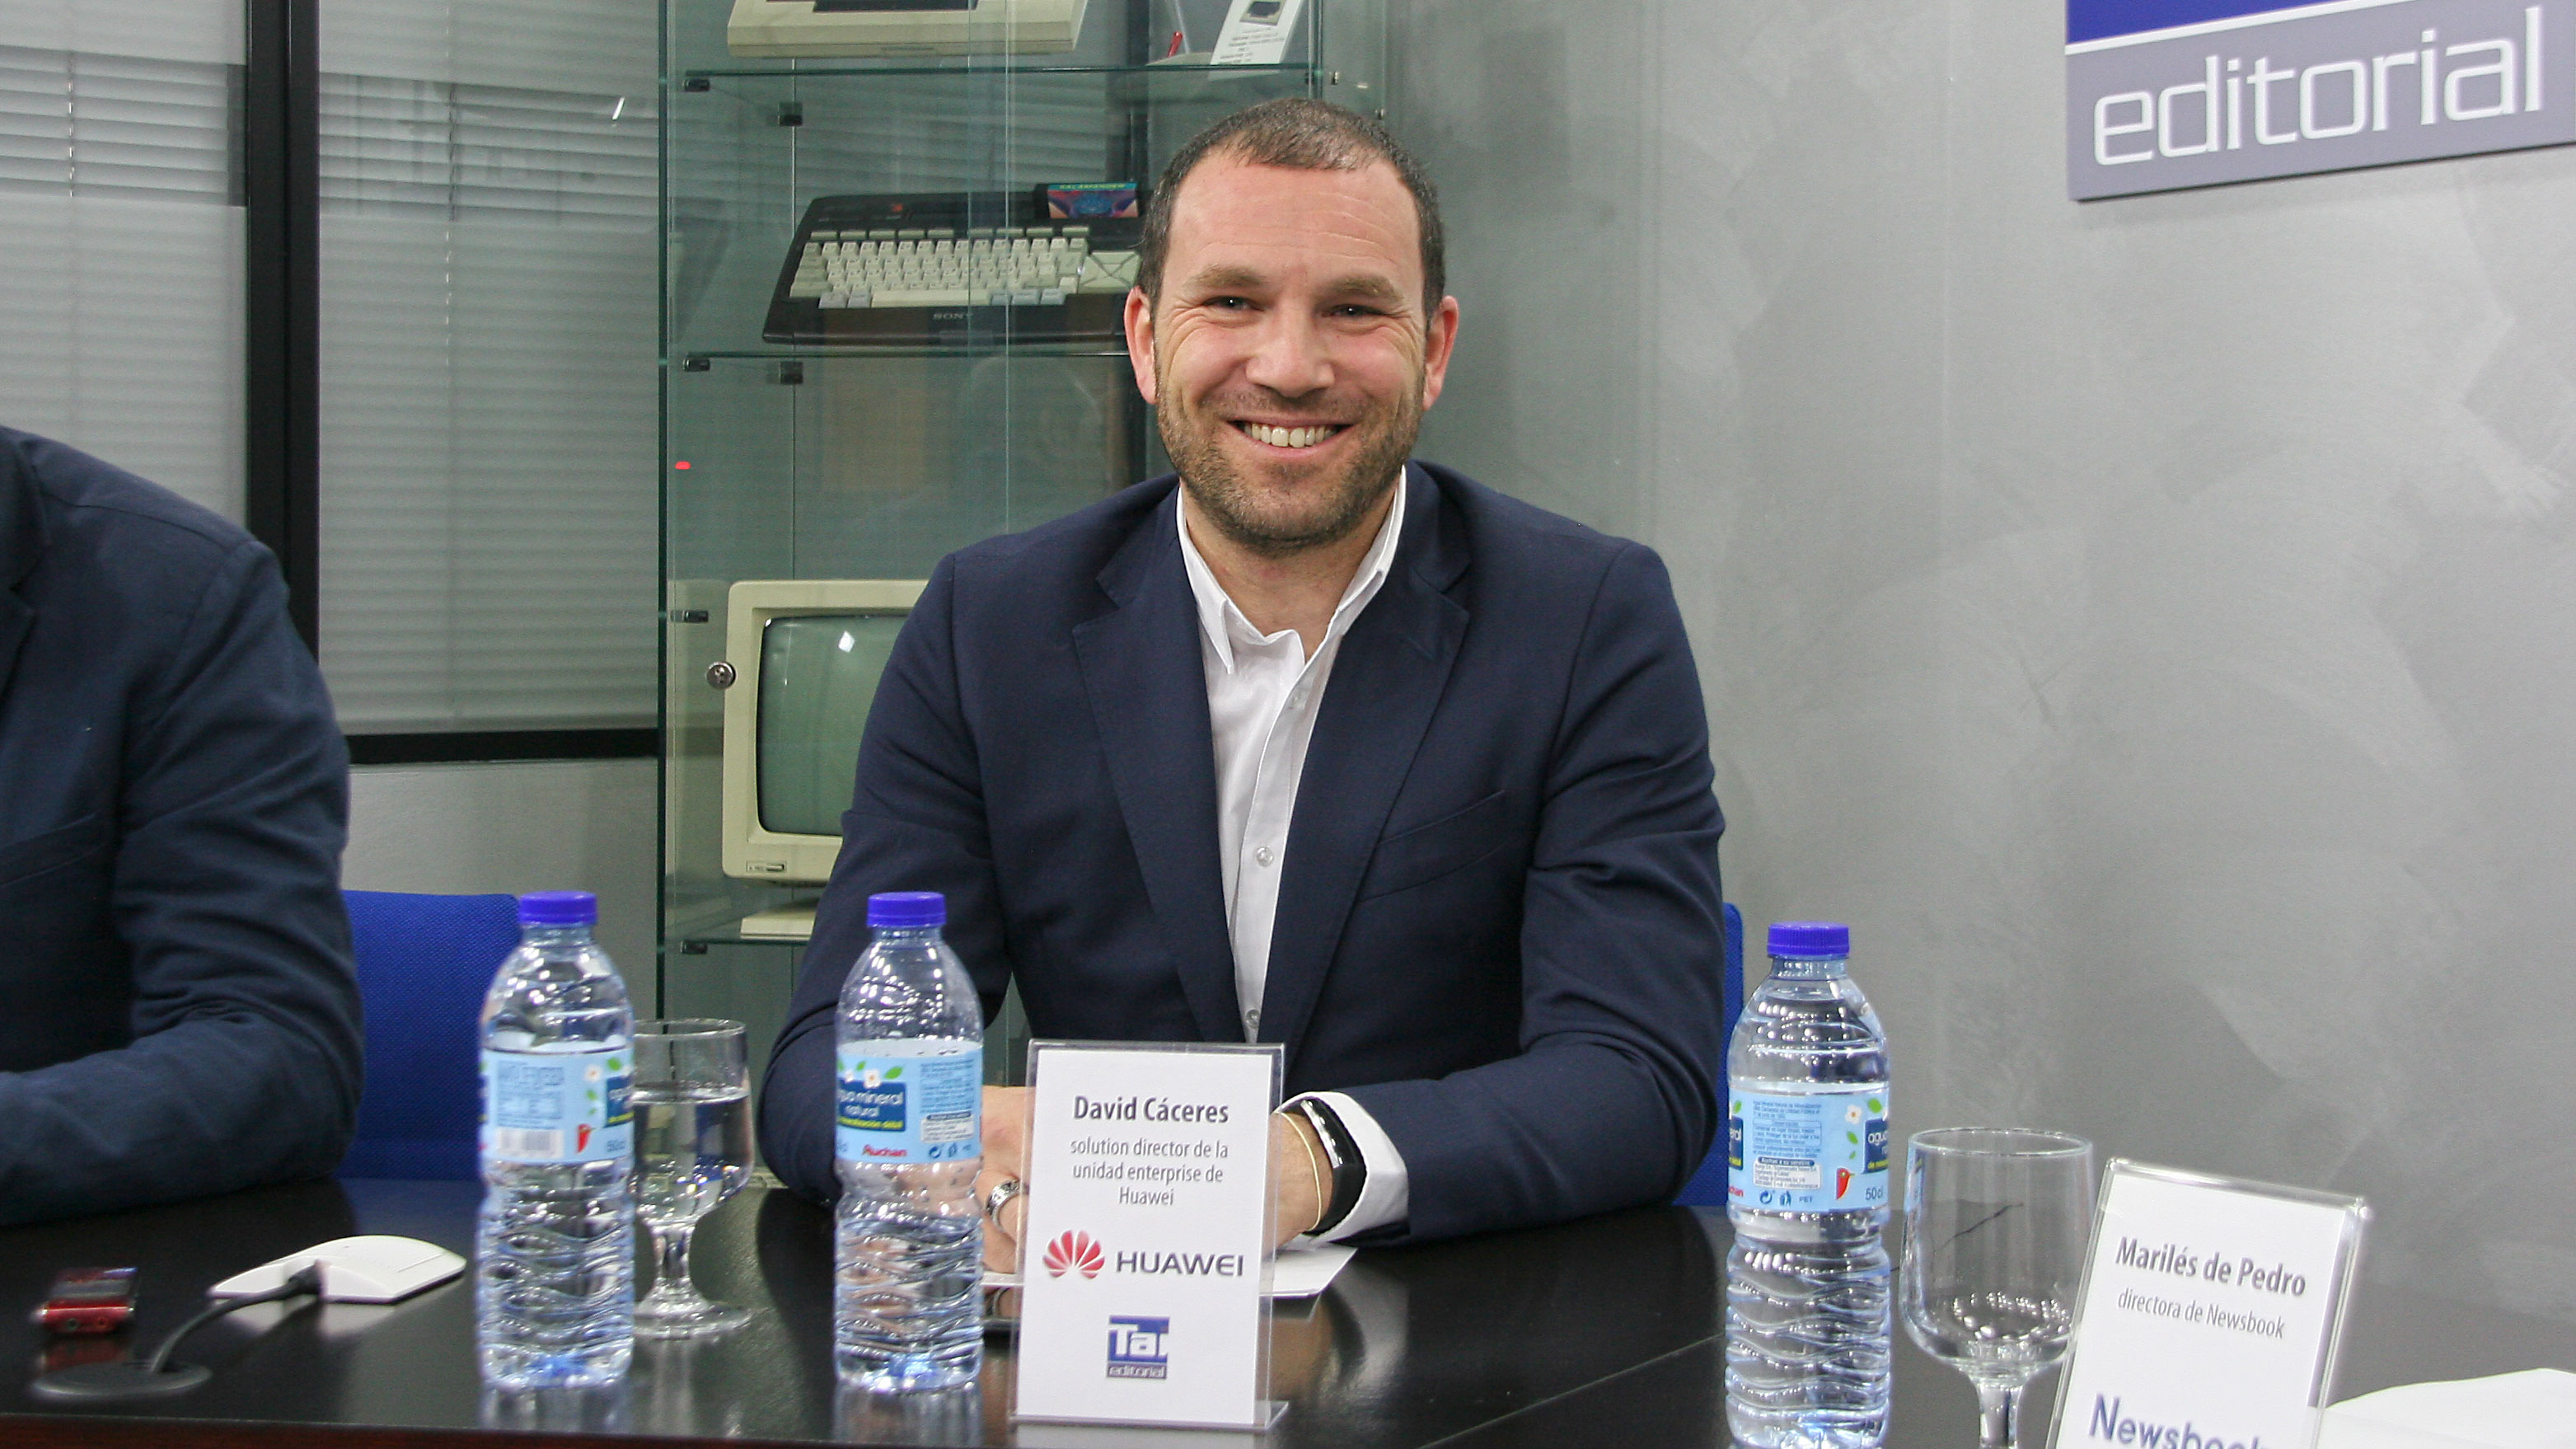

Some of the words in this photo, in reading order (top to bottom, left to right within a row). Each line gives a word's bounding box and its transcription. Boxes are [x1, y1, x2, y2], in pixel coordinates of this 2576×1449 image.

[2094, 6, 2542, 166] editorial
[1074, 1095, 1137, 1120] David
[1143, 1097, 1229, 1123] Cáceres
[1070, 1136, 1129, 1155] solution
[1133, 1137, 1190, 1157] director
[1194, 1139, 1211, 1158] de
[1215, 1140, 1228, 1158] la
[1073, 1161, 1124, 1179] unidad
[1127, 1165, 1201, 1185] enterprise
[1206, 1164, 1224, 1183] de
[1118, 1186, 1174, 1206] Huawei
[1865, 1185, 1884, 1201] 50cl
[1117, 1250, 1244, 1277] HUAWEI
[2115, 1236, 2199, 1278] Marilés
[2202, 1251, 2232, 1283] de
[2236, 1256, 2306, 1297] Pedro
[2117, 1287, 2181, 1319] directora
[2185, 1300, 2204, 1323] de
[2206, 1303, 2285, 1340] Newsbook
[1108, 1364, 1166, 1378] editorial
